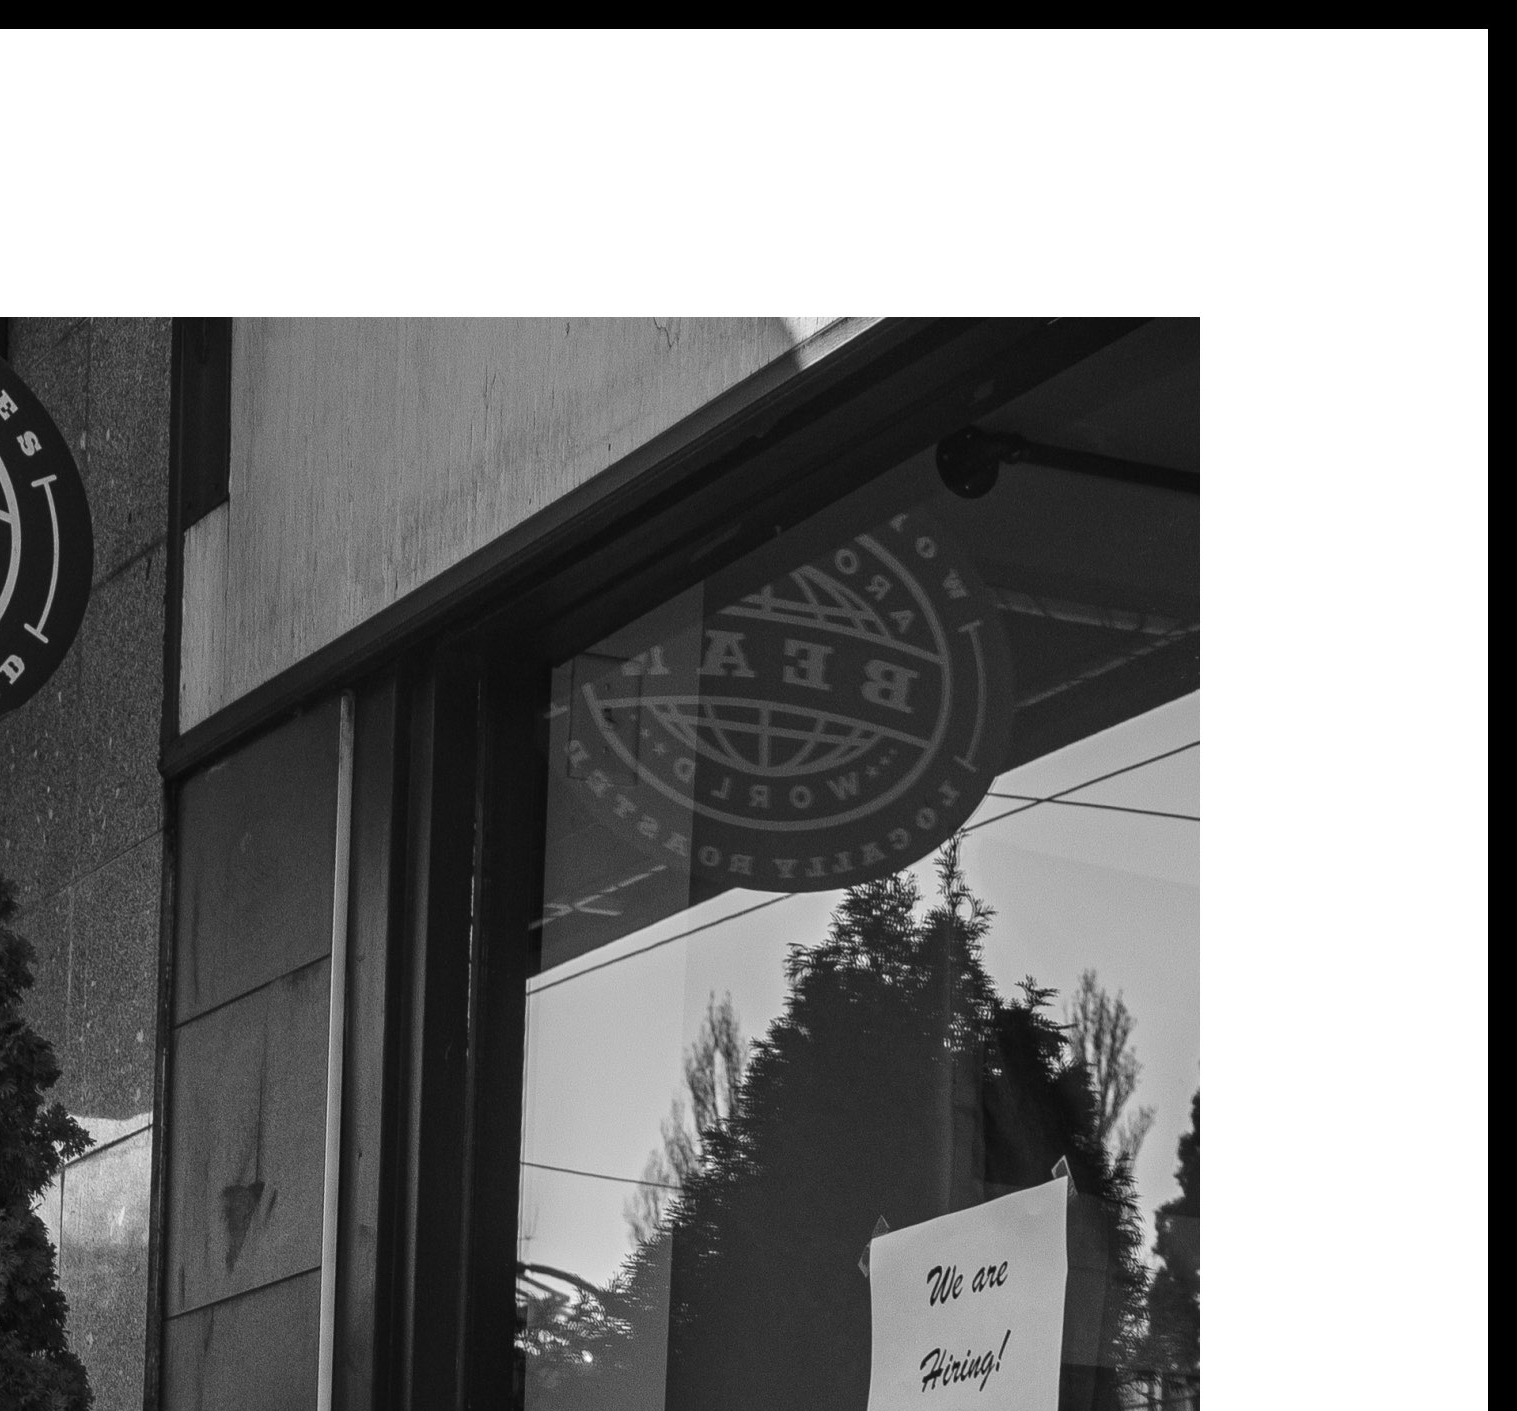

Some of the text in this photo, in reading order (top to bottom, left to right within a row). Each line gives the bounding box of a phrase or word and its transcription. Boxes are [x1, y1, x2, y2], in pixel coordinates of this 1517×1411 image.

[926, 1260, 1009, 1306] We are
[919, 1328, 1012, 1393] Hiring!
